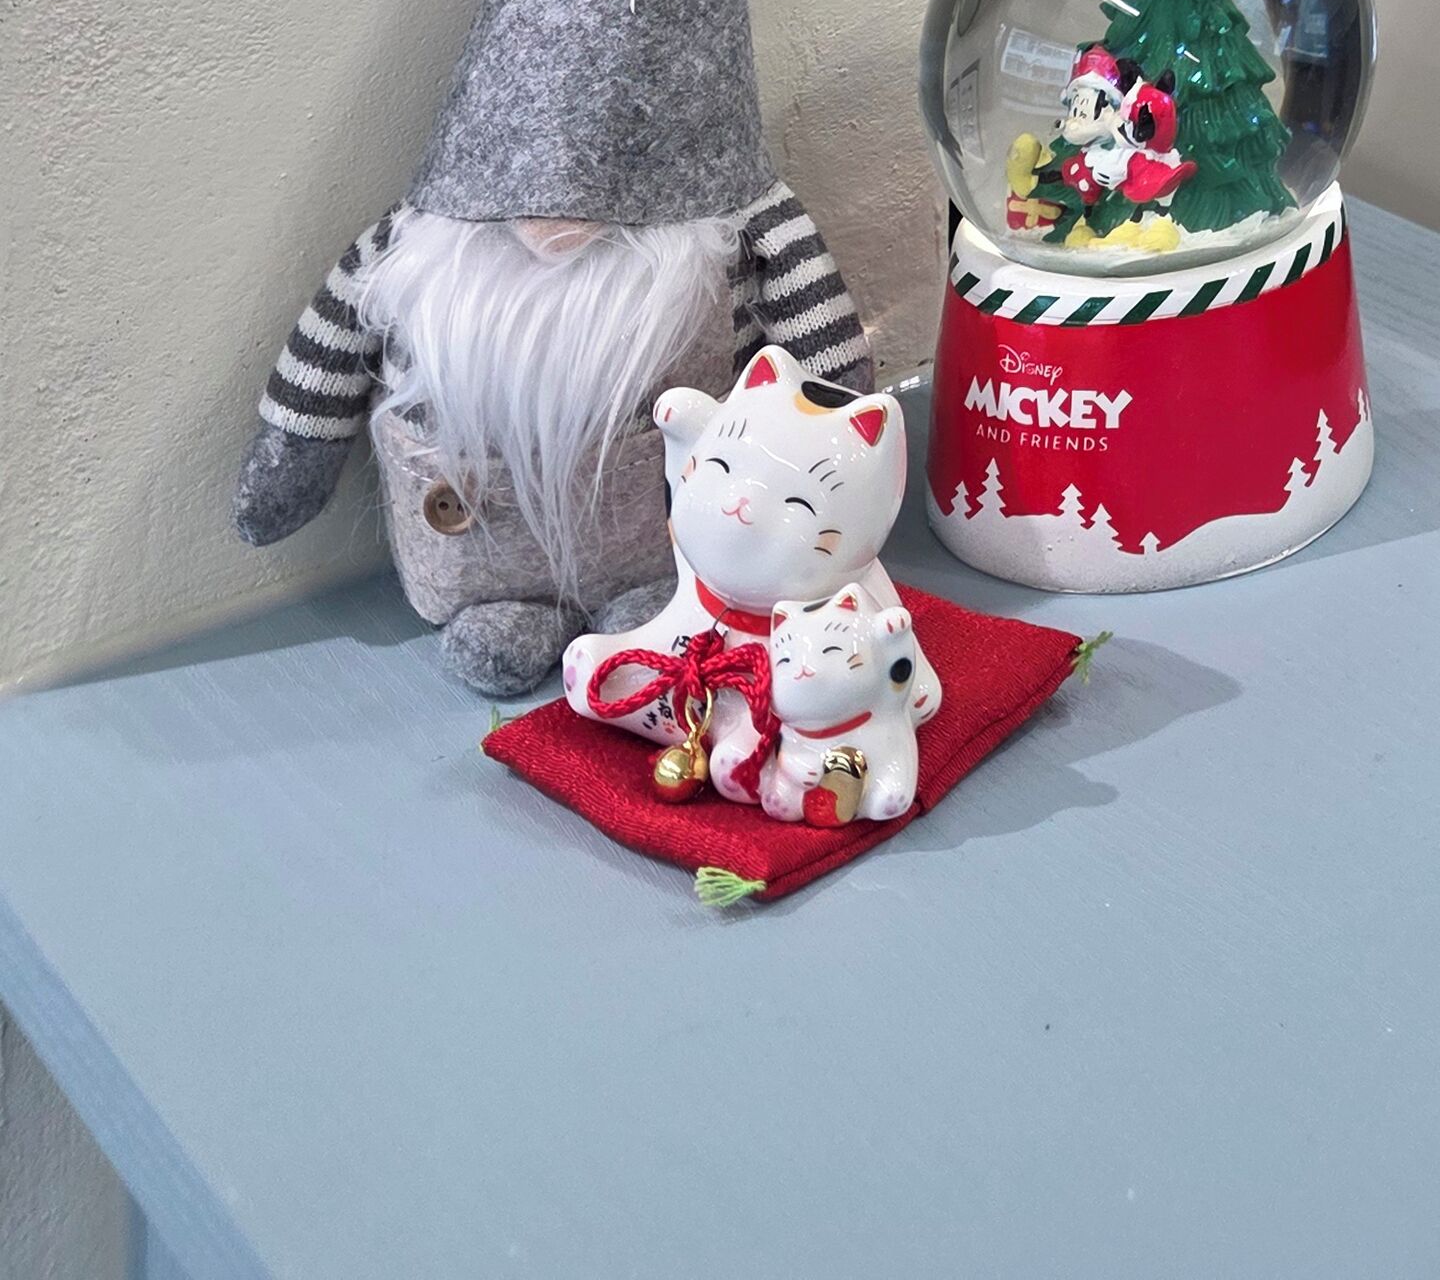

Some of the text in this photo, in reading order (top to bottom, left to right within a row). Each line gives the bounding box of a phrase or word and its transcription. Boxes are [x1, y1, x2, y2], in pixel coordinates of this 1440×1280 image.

[964, 375, 1133, 429] MICKEY
[976, 424, 1109, 452] AND FRIENDS
